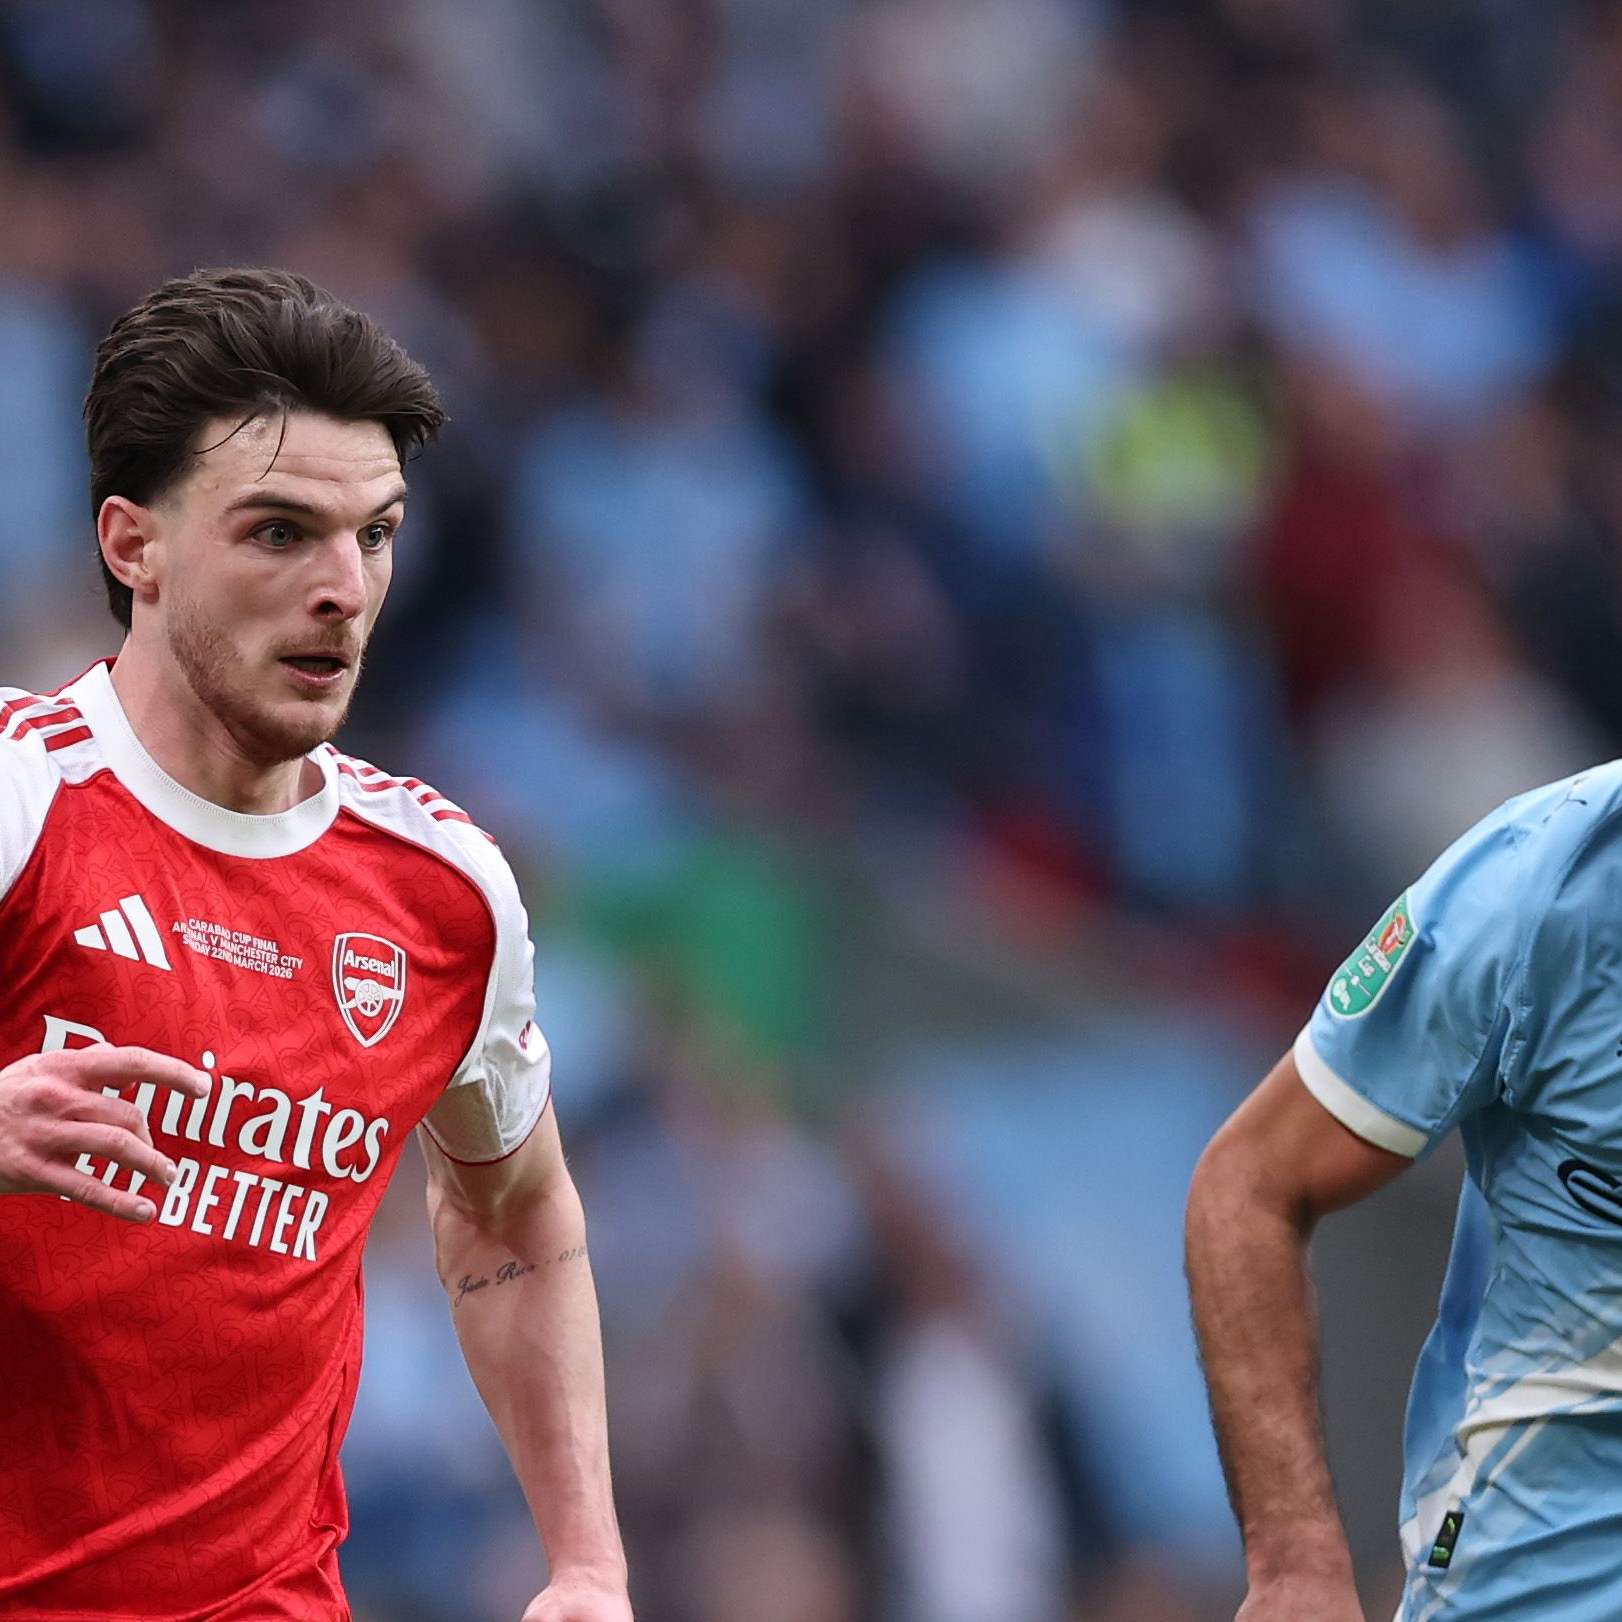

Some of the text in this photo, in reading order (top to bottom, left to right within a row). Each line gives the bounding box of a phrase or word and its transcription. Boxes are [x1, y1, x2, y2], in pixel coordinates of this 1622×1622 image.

[188, 918, 279, 953] CARABAO CUP FINAL
[210, 935, 219, 946] V
[219, 938, 278, 965] MANCHESTER
[280, 955, 304, 970] CITY
[210, 946, 234, 964] 22ND
[233, 955, 268, 975] MARCH
[268, 964, 294, 979] 2026
[344, 949, 395, 978] Arsenal
[158, 1156, 330, 1263] BETTER
